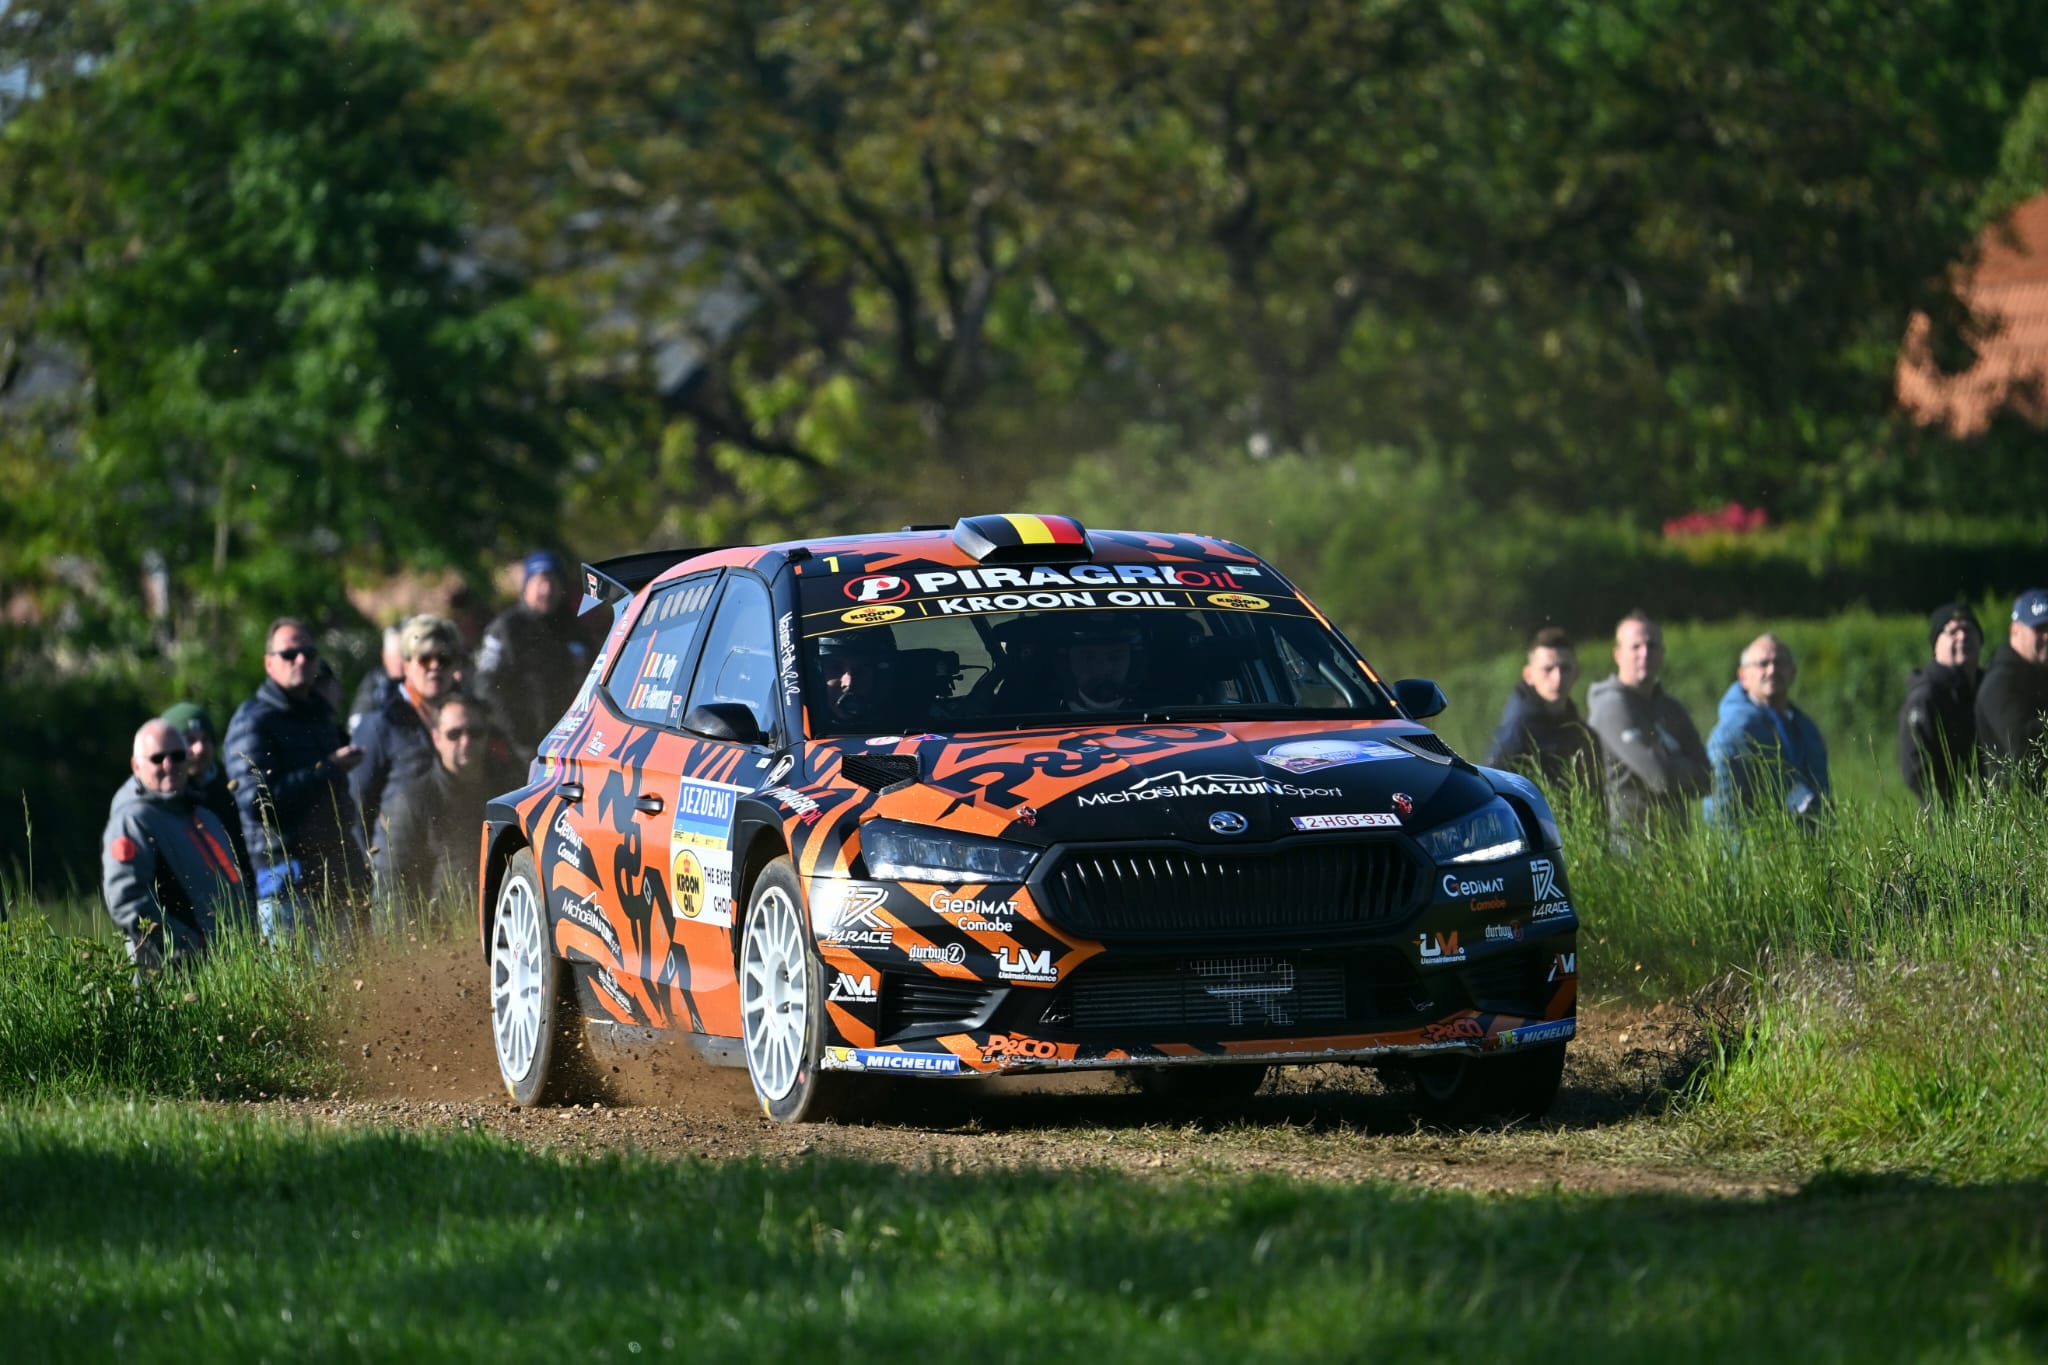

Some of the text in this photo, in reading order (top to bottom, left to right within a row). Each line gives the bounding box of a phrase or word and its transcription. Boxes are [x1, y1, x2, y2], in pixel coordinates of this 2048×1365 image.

[822, 556, 840, 573] 1
[915, 565, 1182, 594] PIRAGRI
[936, 591, 1177, 614] KROON OIL
[1216, 597, 1261, 606] KROON
[850, 609, 896, 620] KROON
[680, 786, 730, 820] SEZOENS
[1078, 781, 1343, 807] Michaël MAZUIN Sport
[1306, 813, 1398, 828] 2-HGG-931
[676, 874, 699, 895] KROON
[704, 866, 715, 884] THE
[684, 894, 695, 913] OIL
[957, 917, 1013, 932] Comobe
[1523, 1023, 1574, 1042] MICHELIN
[984, 1034, 1057, 1059] P&CO
[866, 1055, 956, 1071] MICHELIN
